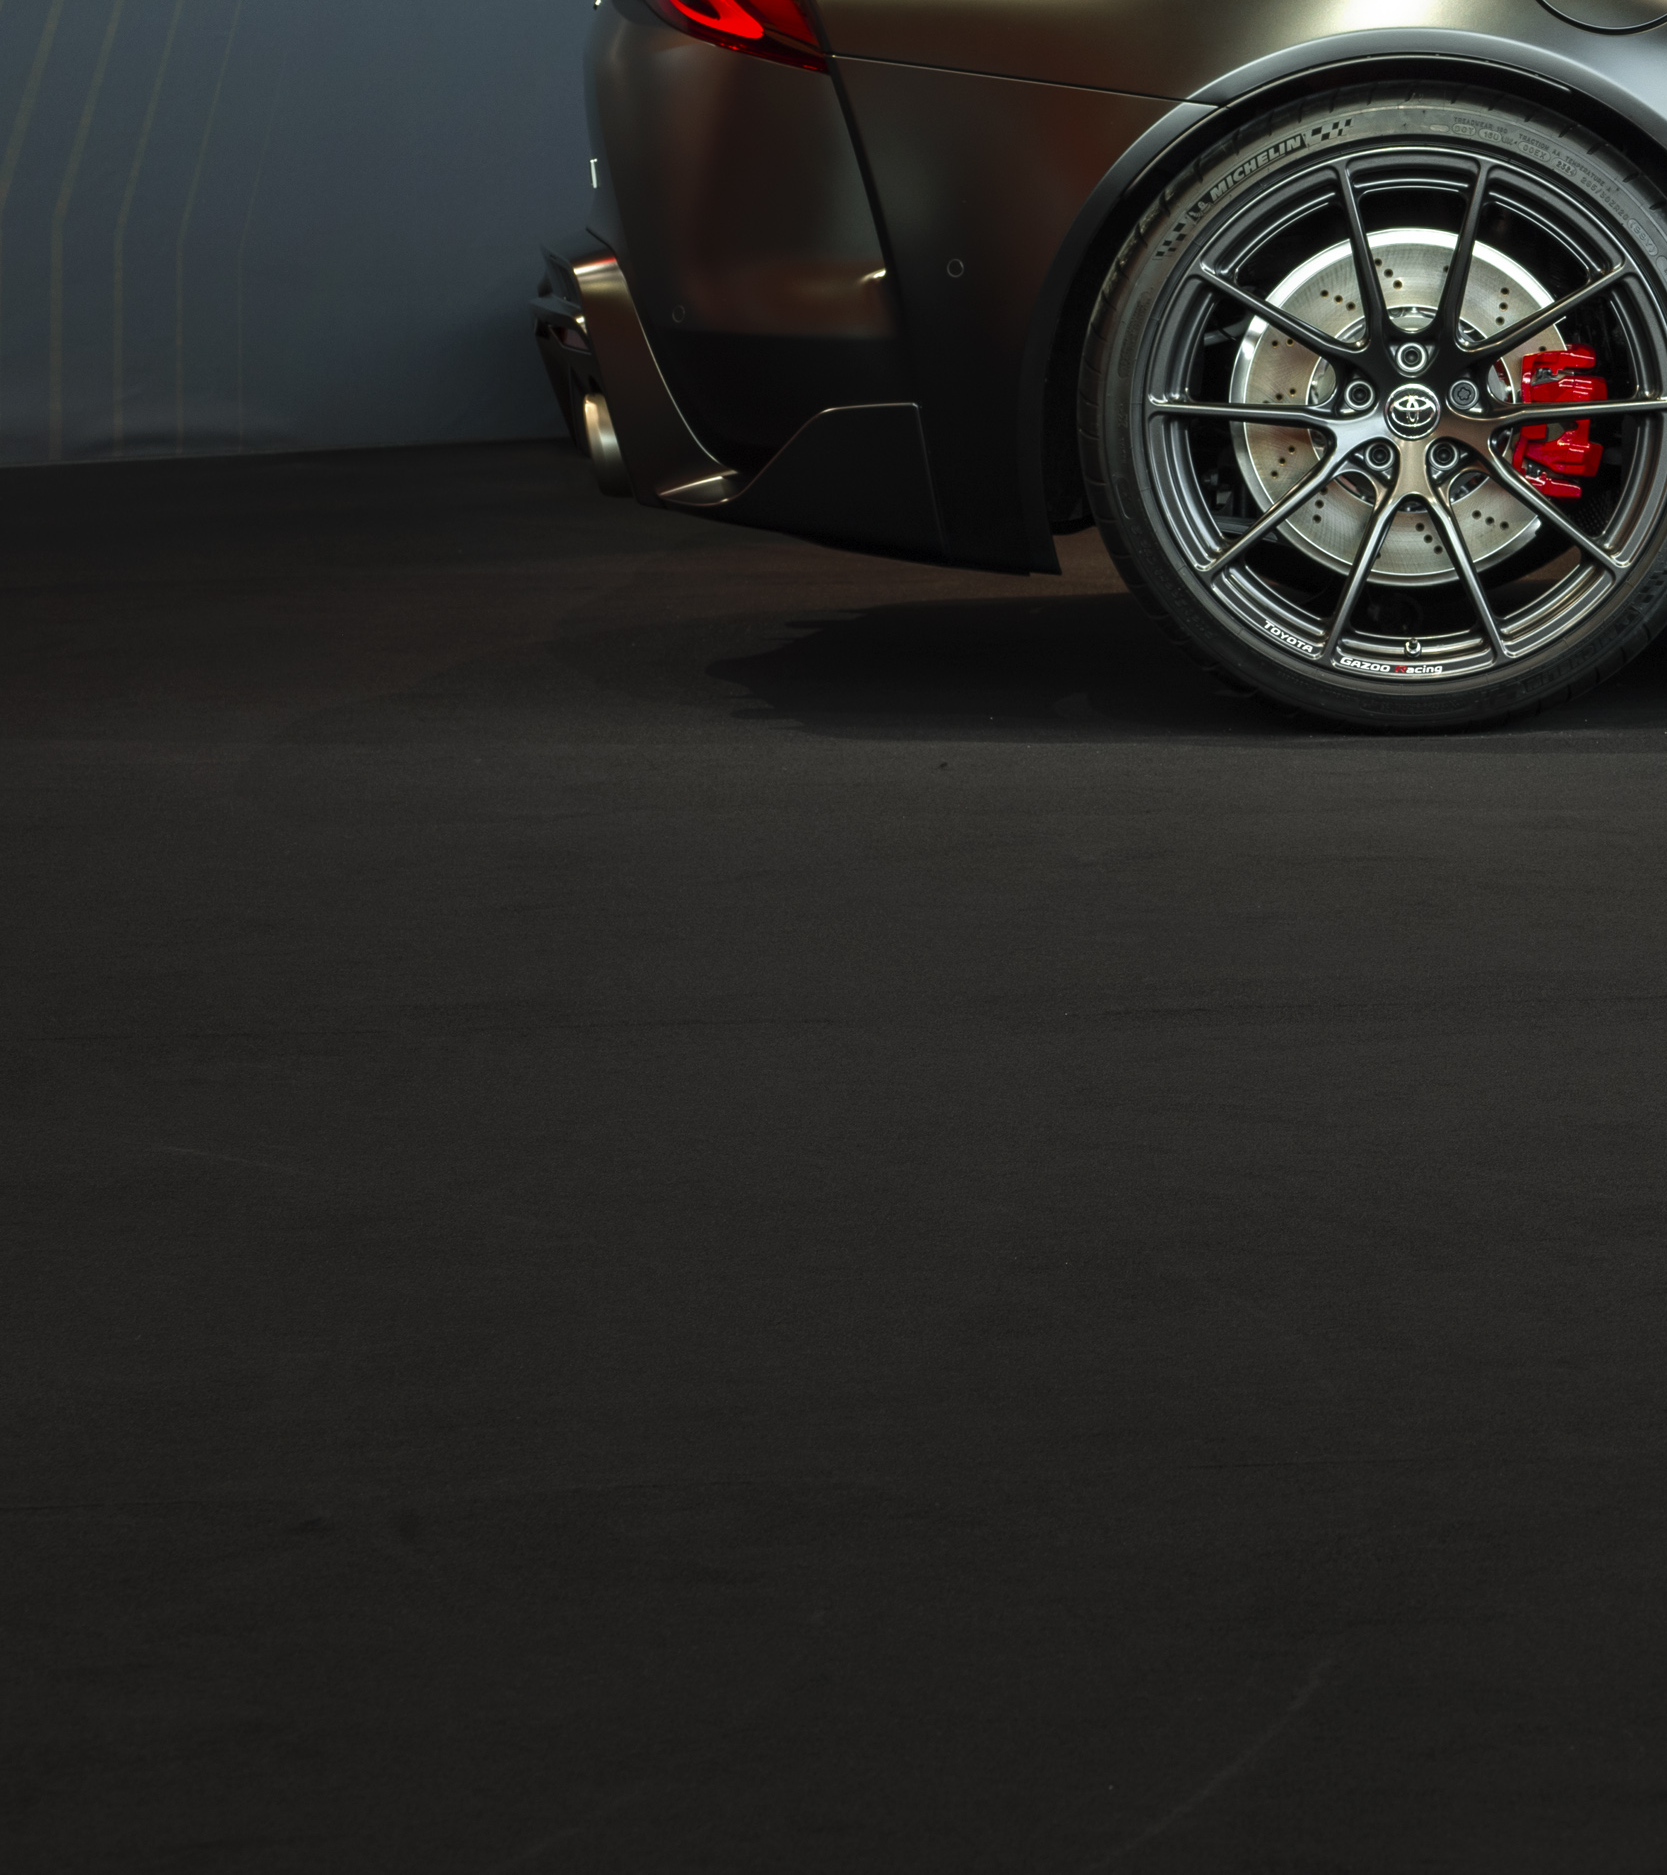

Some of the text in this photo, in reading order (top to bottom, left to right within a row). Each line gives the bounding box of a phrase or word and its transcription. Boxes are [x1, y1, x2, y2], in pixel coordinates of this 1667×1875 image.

[1206, 133, 1304, 202] MICHELIN
[1263, 620, 1313, 653] TOYOTA
[1340, 656, 1443, 674] GAZOO Racing
